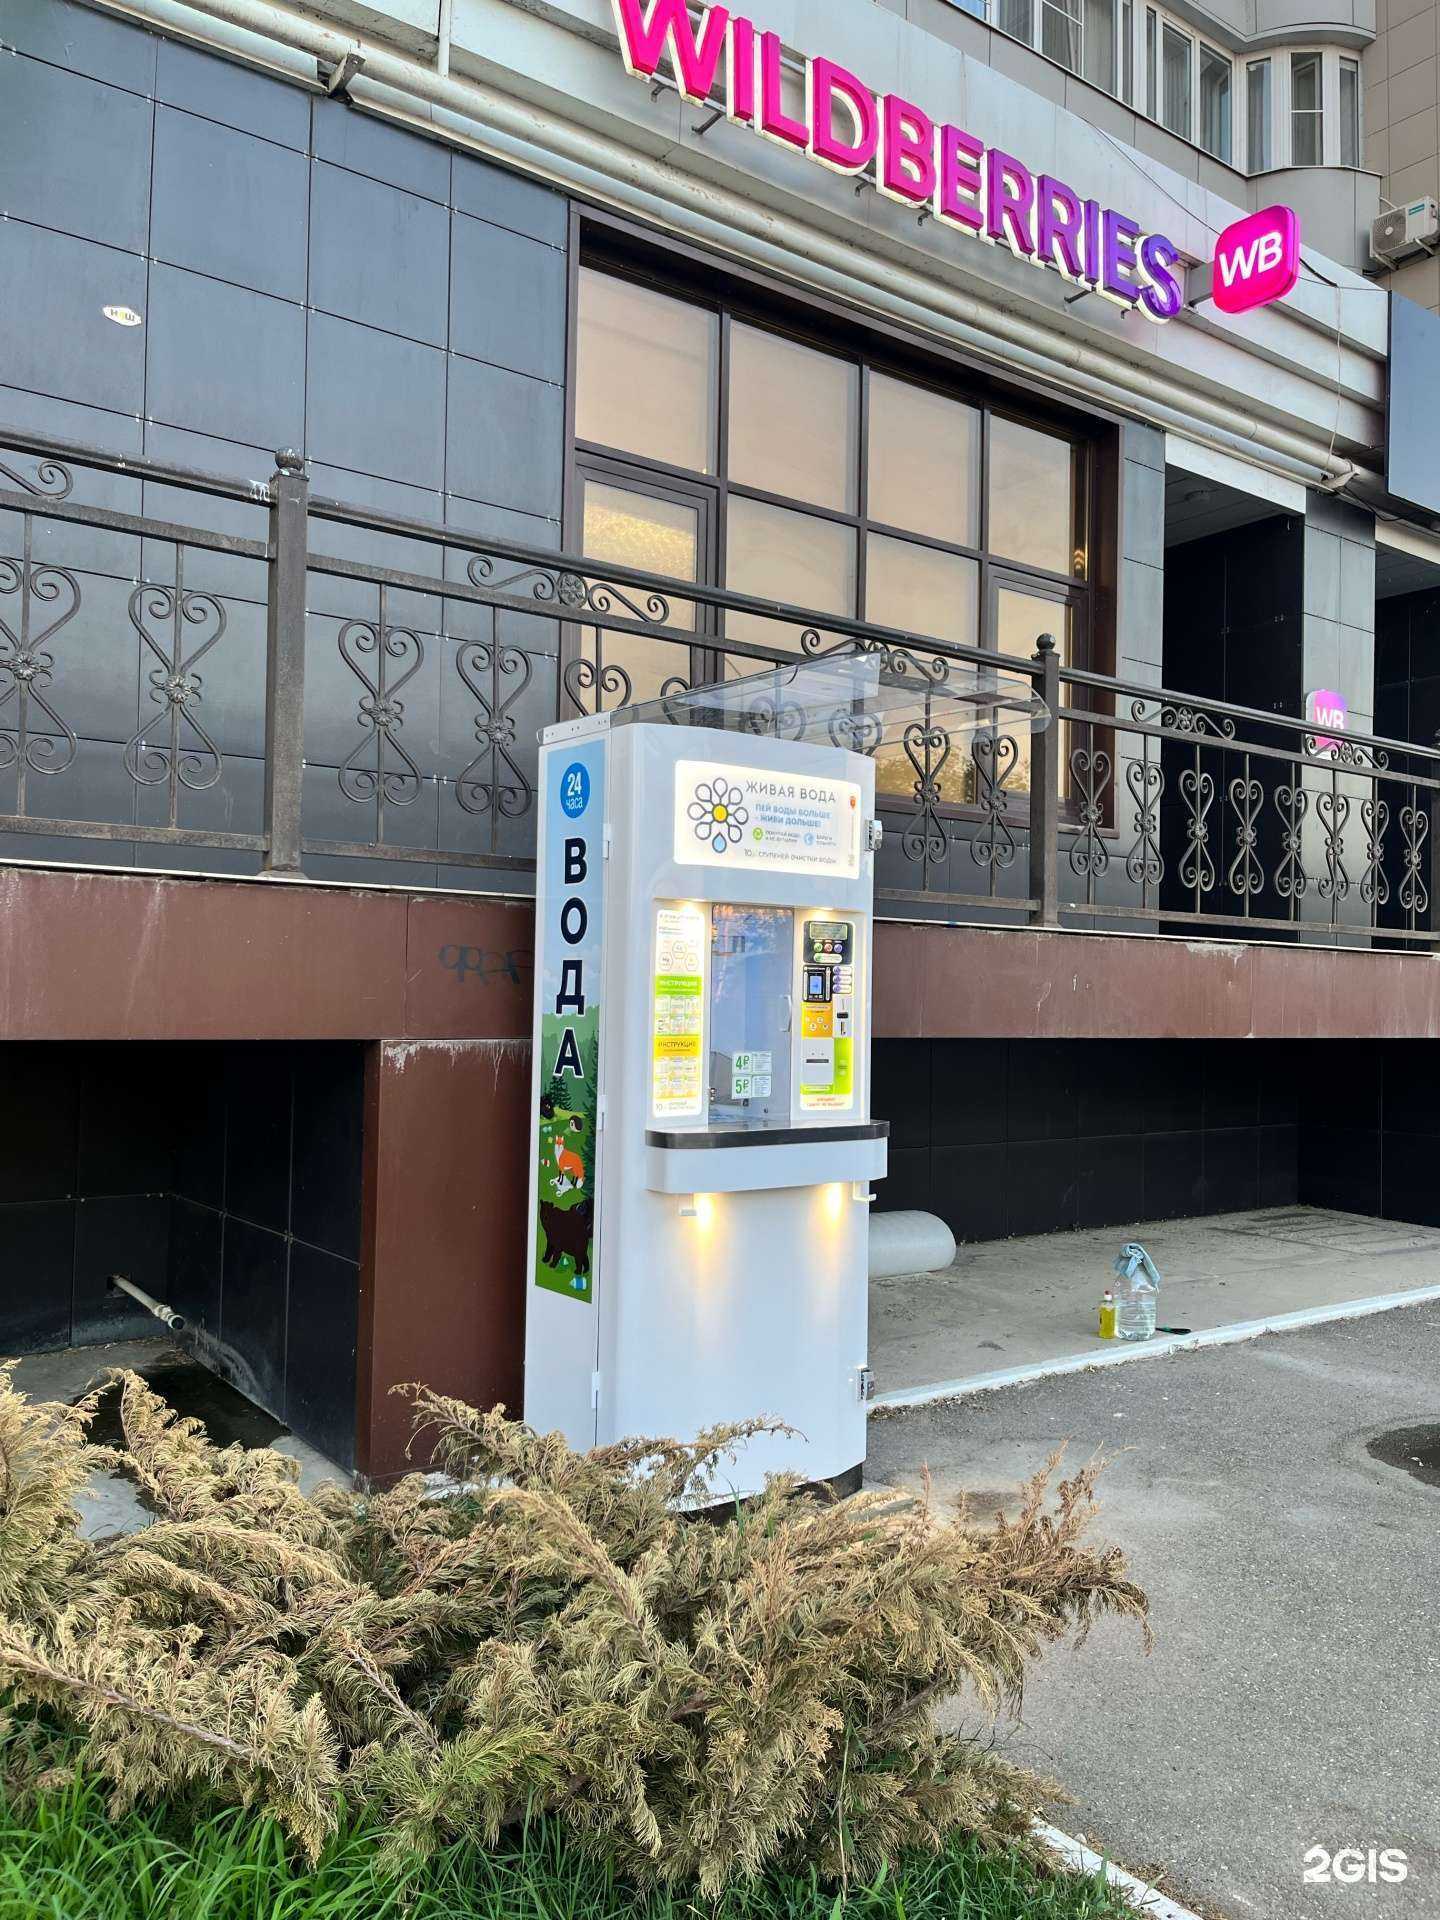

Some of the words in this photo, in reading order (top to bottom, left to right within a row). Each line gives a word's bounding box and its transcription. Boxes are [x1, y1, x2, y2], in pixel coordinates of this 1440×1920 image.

[612, 0, 1181, 323] WILDBERRIES
[1219, 231, 1283, 288] WB
[567, 772, 582, 796] 24
[745, 780, 795, 798] ЖИВАЯ
[800, 788, 837, 803] ВОДА
[566, 797, 583, 810] часа
[755, 803, 772, 813] ПЕЙ
[773, 805, 797, 815] ВОДЫ
[553, 837, 588, 1078] ВОДА
